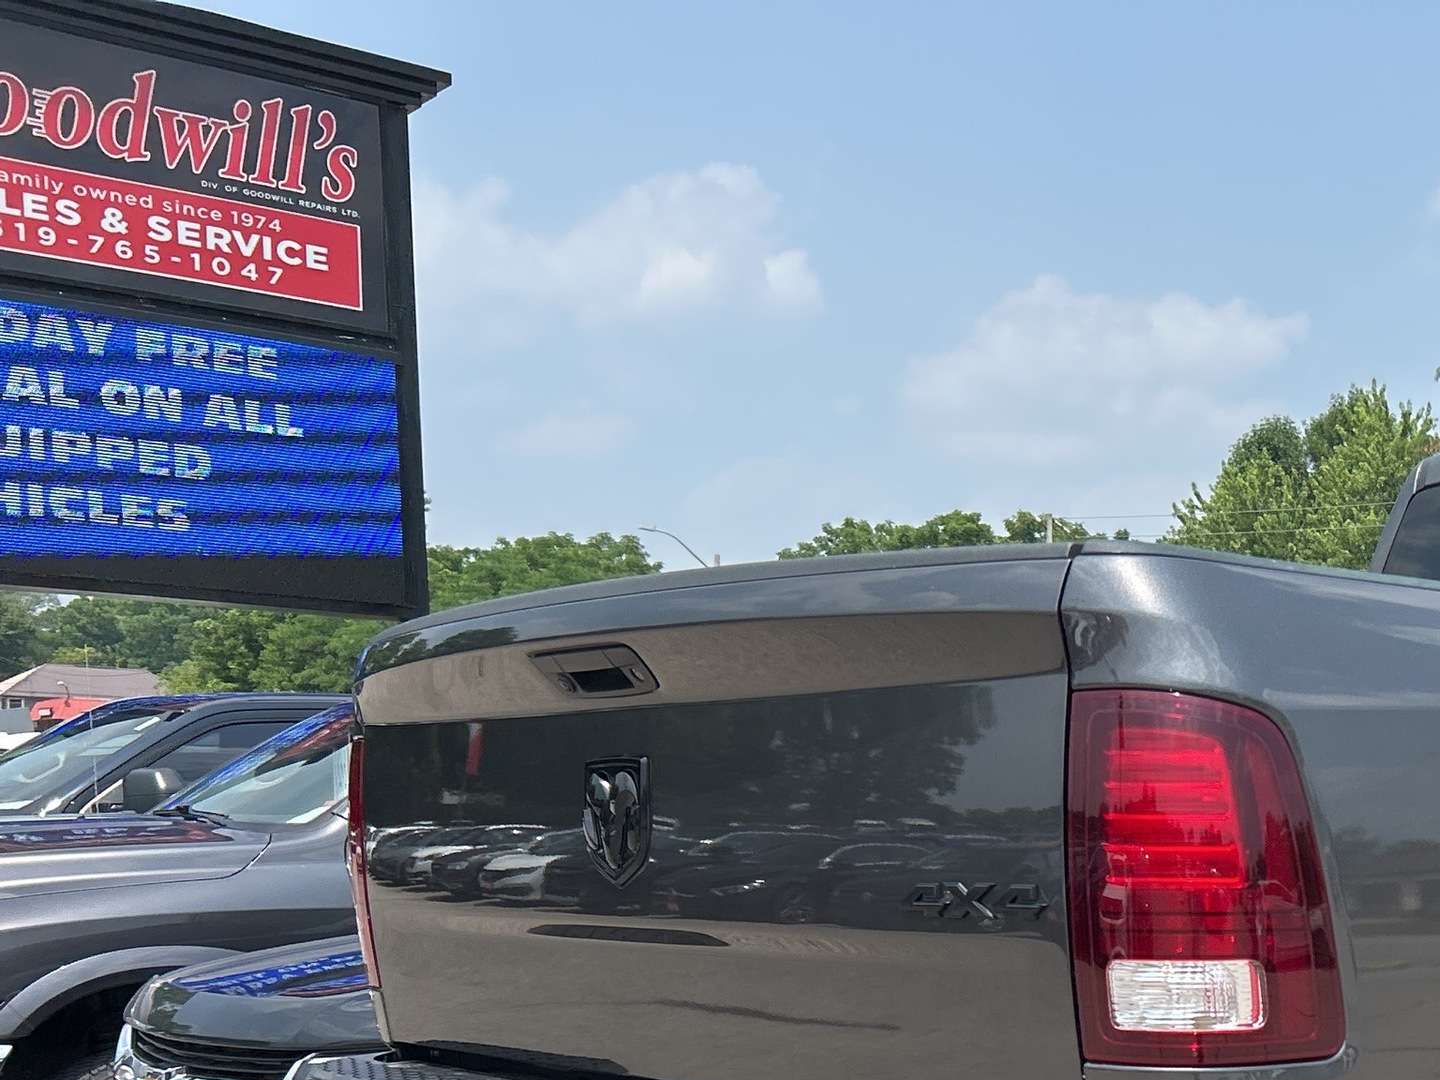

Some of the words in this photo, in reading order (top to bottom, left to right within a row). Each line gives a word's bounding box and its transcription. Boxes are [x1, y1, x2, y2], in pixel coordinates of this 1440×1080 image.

[0, 188, 82, 226] LES
[100, 207, 129, 235] &
[147, 215, 330, 272] SERVICE
[73, 184, 153, 209] owned
[162, 199, 223, 221] since
[231, 210, 282, 233] 1974
[201, 180, 219, 191] DIV.
[225, 185, 239, 193] OF
[243, 189, 295, 205] GOODWILL
[298, 200, 338, 213] REPAIRS
[341, 209, 361, 218] LTD.
[0, 219, 284, 285] 19-765-1047
[0, 307, 113, 356] DAY
[136, 326, 279, 380] FREE
[1, 365, 80, 409] AL
[100, 380, 182, 423] ON
[203, 394, 304, 438] ALL
